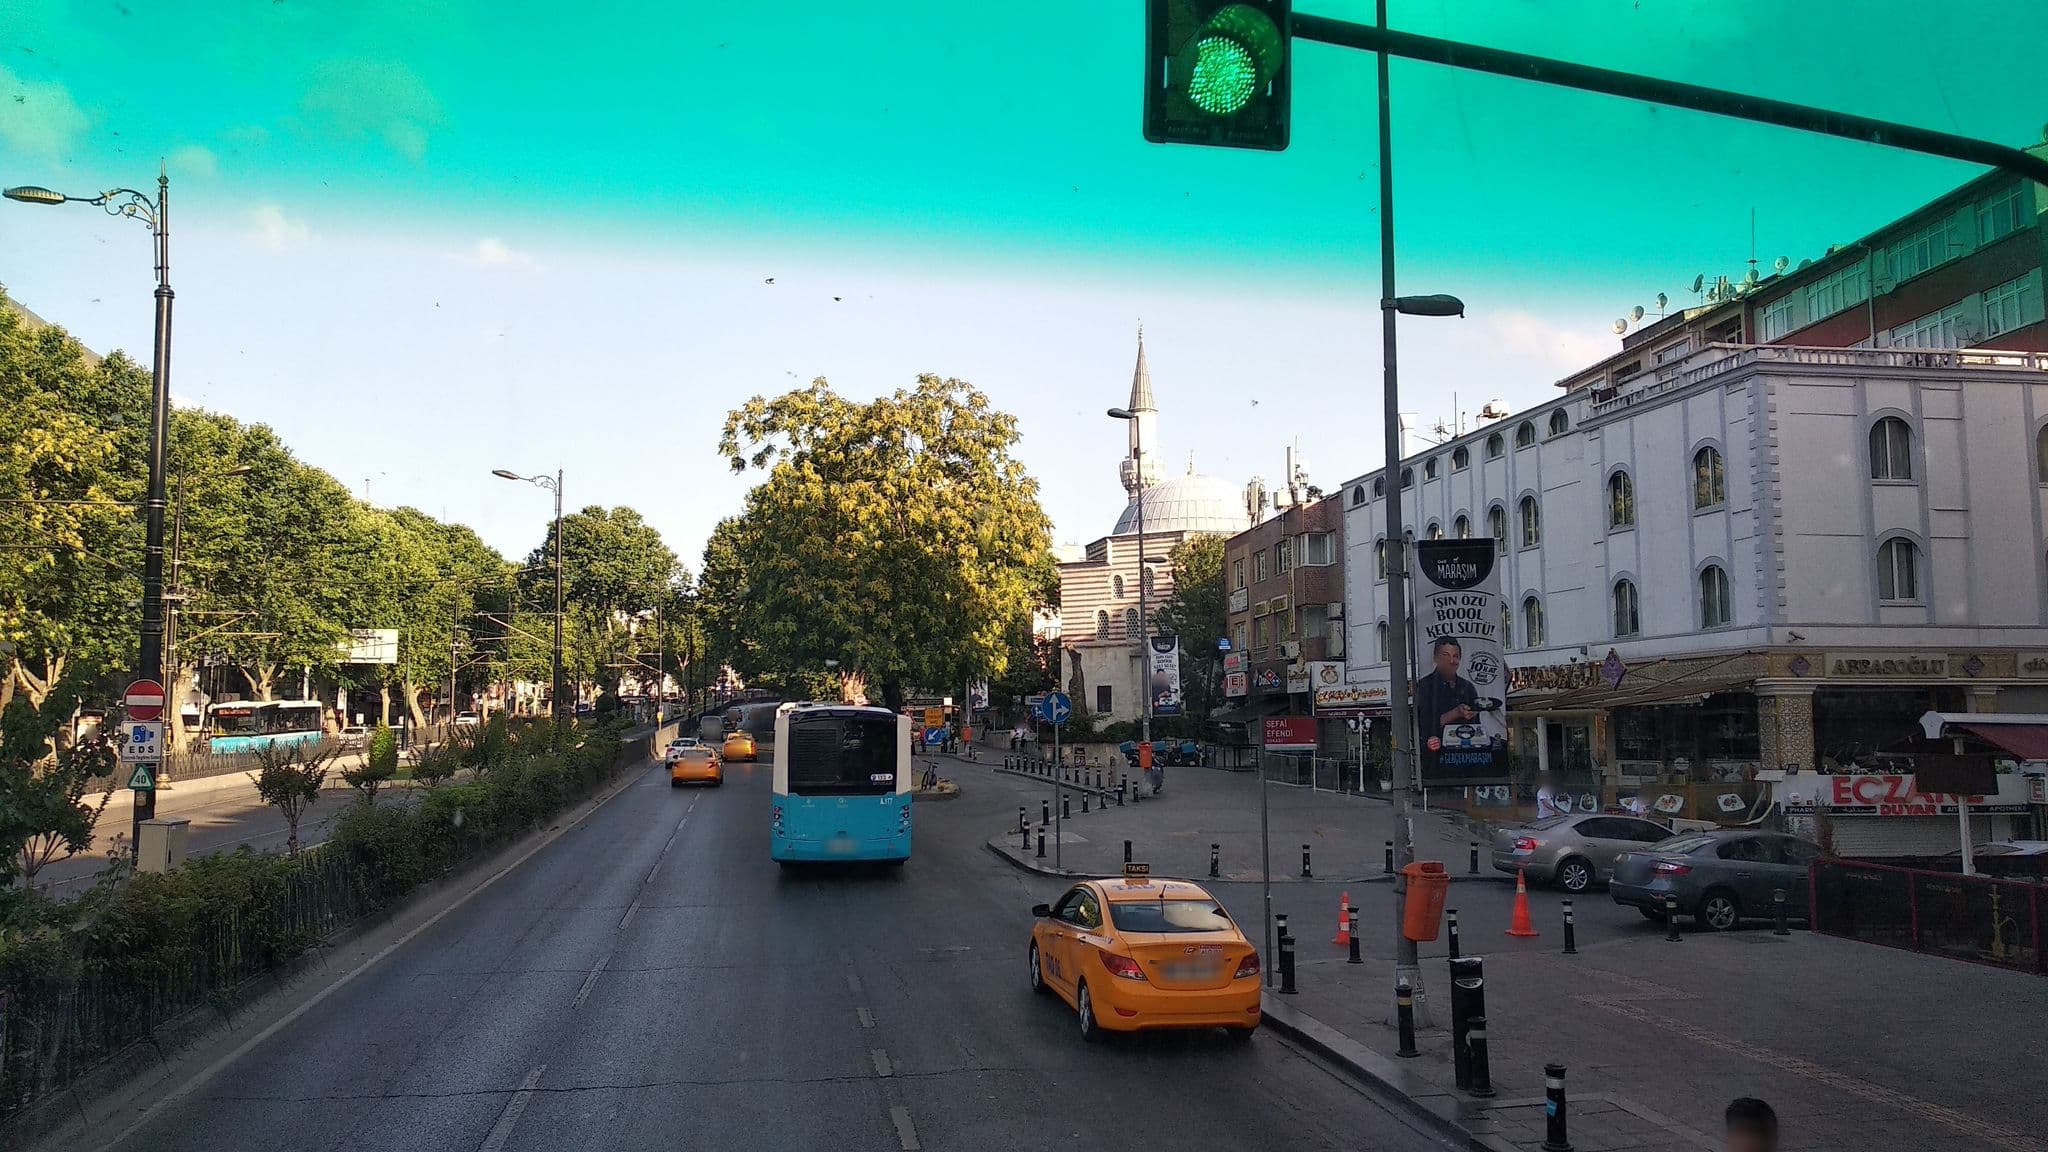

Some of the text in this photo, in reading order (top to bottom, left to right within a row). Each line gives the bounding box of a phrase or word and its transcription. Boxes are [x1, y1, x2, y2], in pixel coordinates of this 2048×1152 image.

[1437, 563, 1477, 580] MARAŞIM
[1436, 607, 1484, 621] BOOOL
[1470, 661, 1483, 671] 10
[135, 774, 146, 784] 40
[1880, 804, 1937, 815] DUYAR
